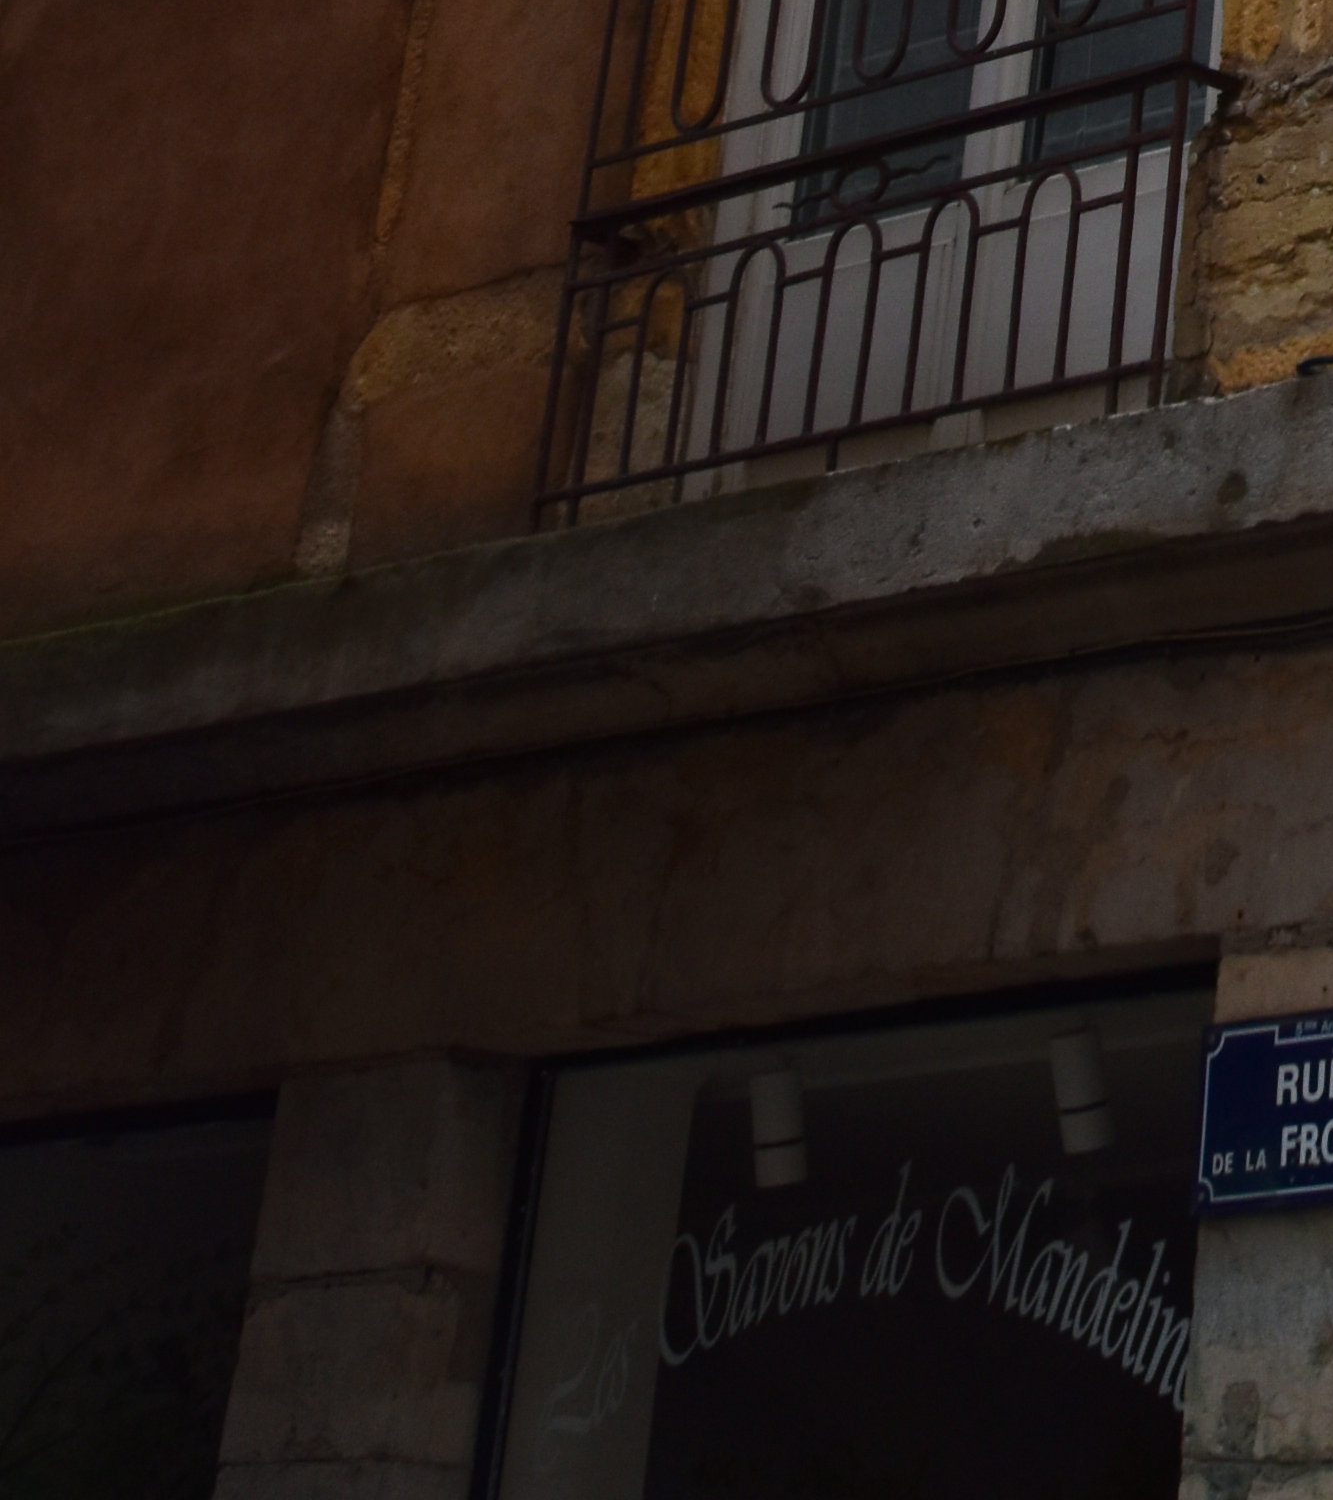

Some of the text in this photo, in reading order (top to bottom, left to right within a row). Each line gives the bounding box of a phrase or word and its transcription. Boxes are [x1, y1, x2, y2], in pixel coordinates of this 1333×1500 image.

[1212, 1152, 1235, 1176] DE
[1244, 1149, 1267, 1172] LA
[658, 1204, 859, 1367] Savons
[860, 1161, 922, 1298] de
